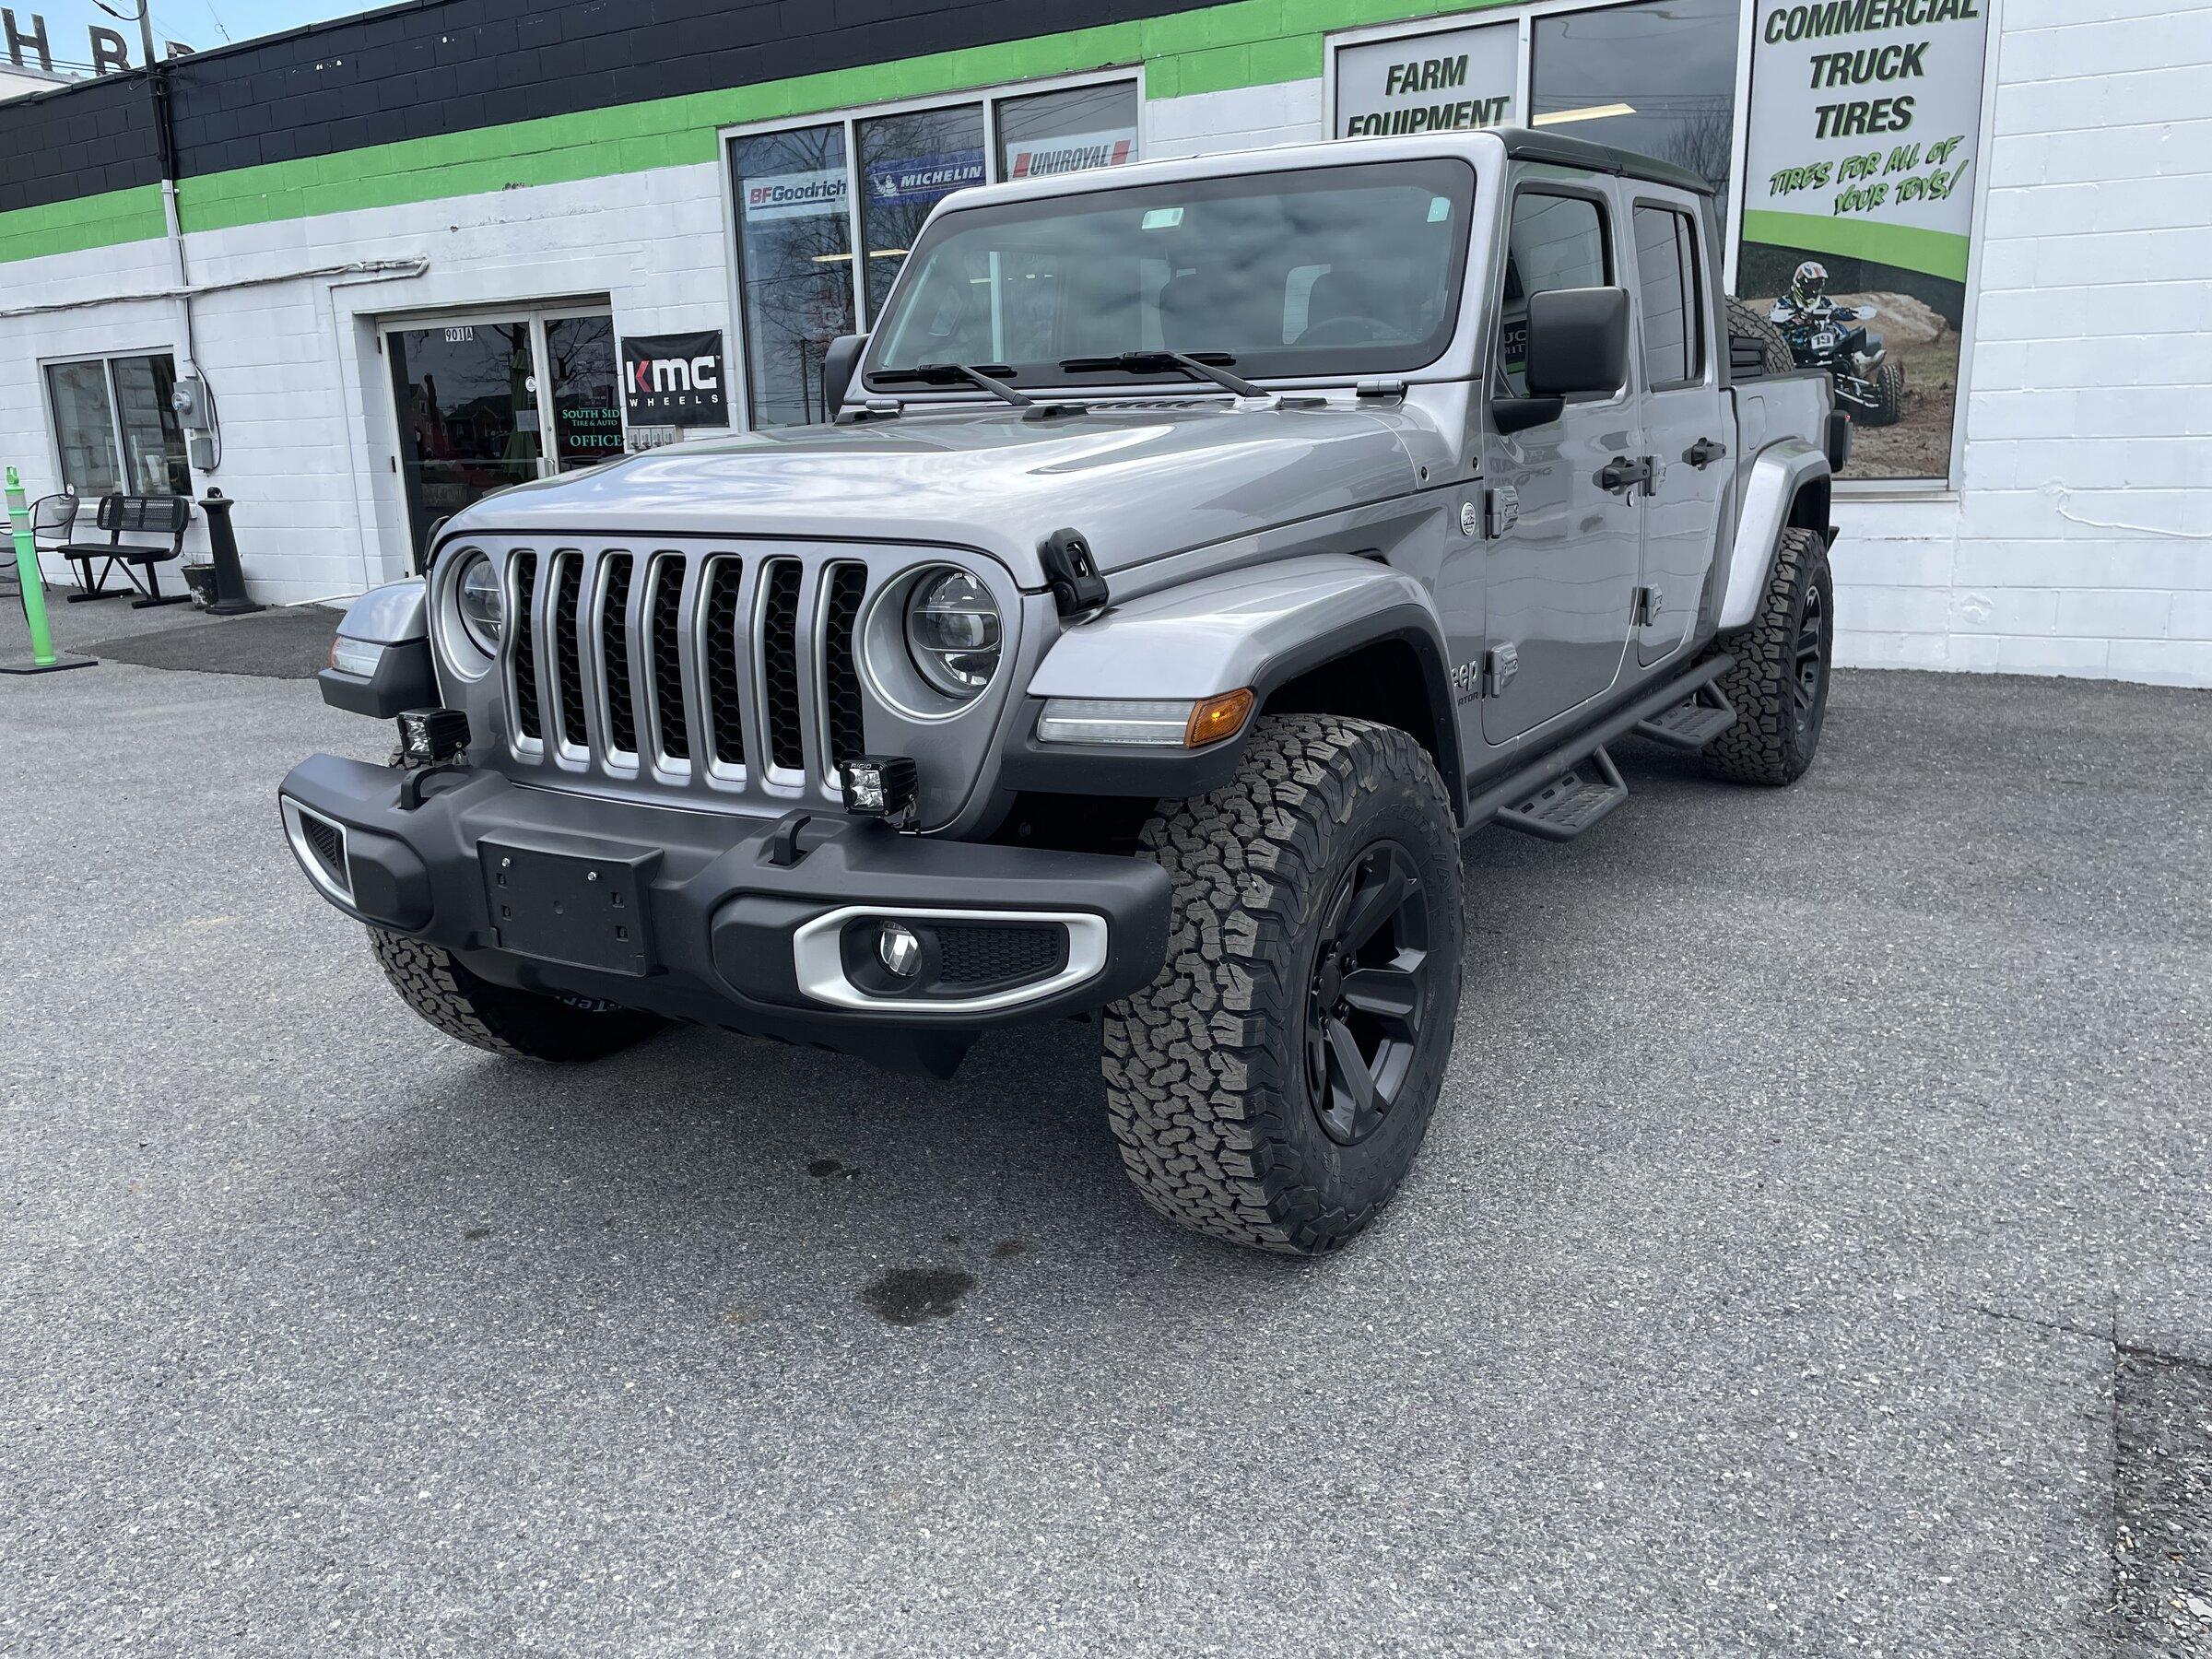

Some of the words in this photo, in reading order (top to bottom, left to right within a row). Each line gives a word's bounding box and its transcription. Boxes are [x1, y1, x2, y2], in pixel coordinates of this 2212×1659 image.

[1385, 54, 1469, 96] FARM
[1810, 41, 1931, 89] TRUCK
[1347, 95, 1511, 138] EQUIPMENT
[1815, 95, 1916, 139] TIRES
[1030, 145, 1109, 175] UNIROYAL
[1771, 161, 1834, 197] TIRES
[1837, 152, 1882, 184] FOR
[1882, 142, 1921, 176] ALL
[1925, 135, 1965, 165] OF
[900, 165, 982, 188] MICHELIN
[1834, 183, 1889, 216] YOUR
[1896, 159, 1970, 206] TOYS!
[749, 180, 847, 204] BFGoodrich
[1816, 334, 1831, 346] 19
[562, 409, 599, 419] SOUTH
[602, 408, 620, 418] SID
[629, 394, 719, 407] WHEELS
[570, 434, 623, 447] OFFICE
[1452, 660, 1478, 691] eep
[1457, 691, 1478, 707] ATOR
